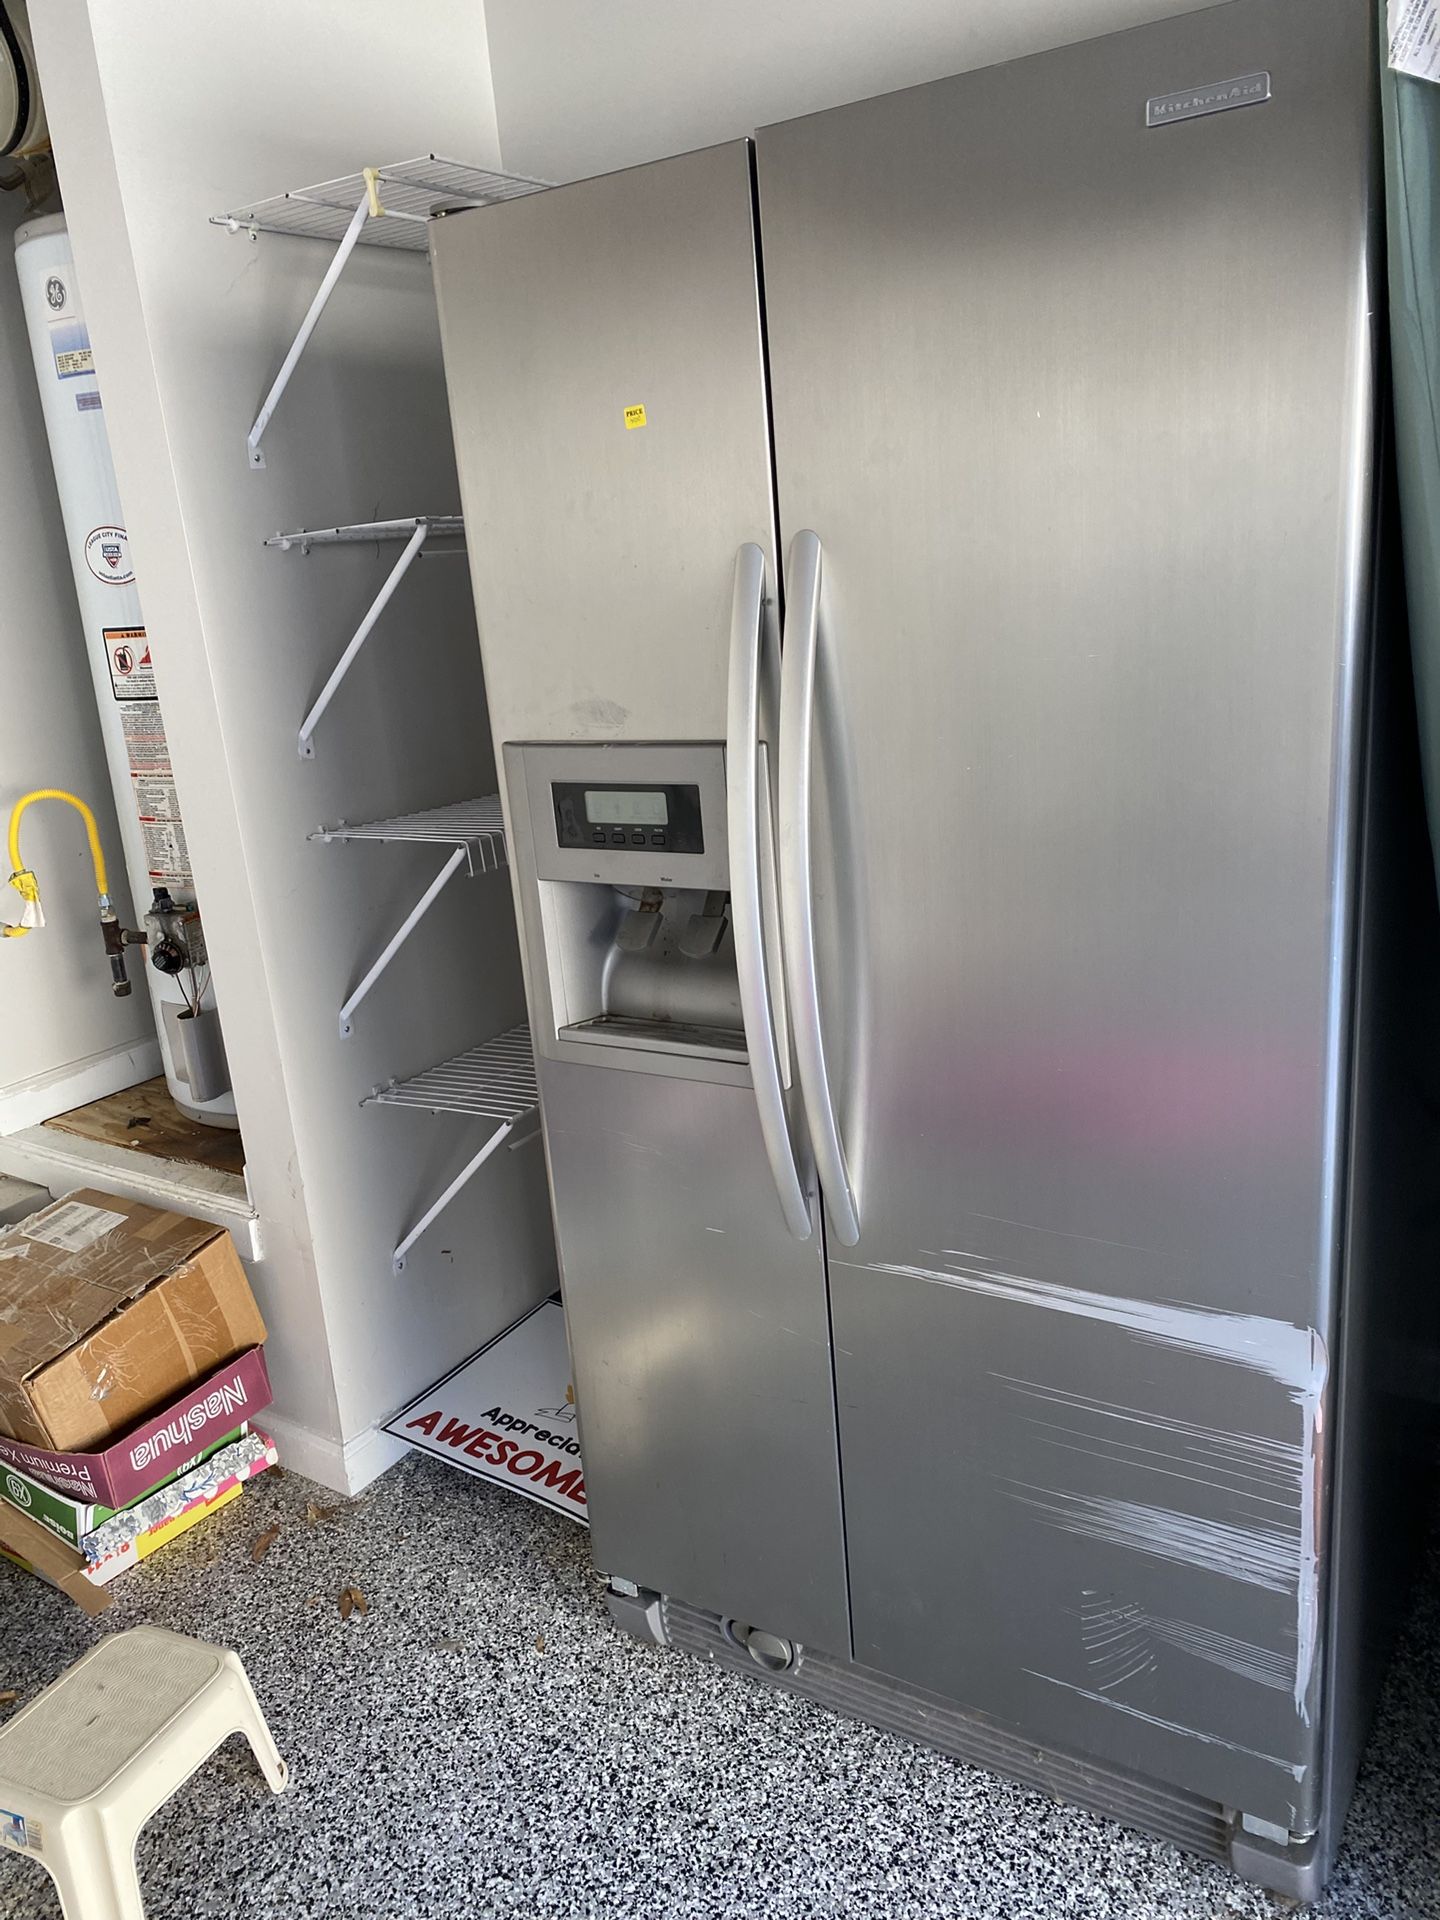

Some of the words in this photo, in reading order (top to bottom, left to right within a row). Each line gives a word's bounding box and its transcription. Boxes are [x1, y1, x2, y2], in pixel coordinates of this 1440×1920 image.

[1153, 82, 1262, 116] KitchenAid
[626, 408, 643, 418] PRICE
[129, 1375, 248, 1471] Nashua
[480, 1407, 582, 1459] Apprecia
[20, 1452, 91, 1481] Premium
[405, 1411, 588, 1505] AWESOME
[28, 1467, 98, 1498] Nashua
